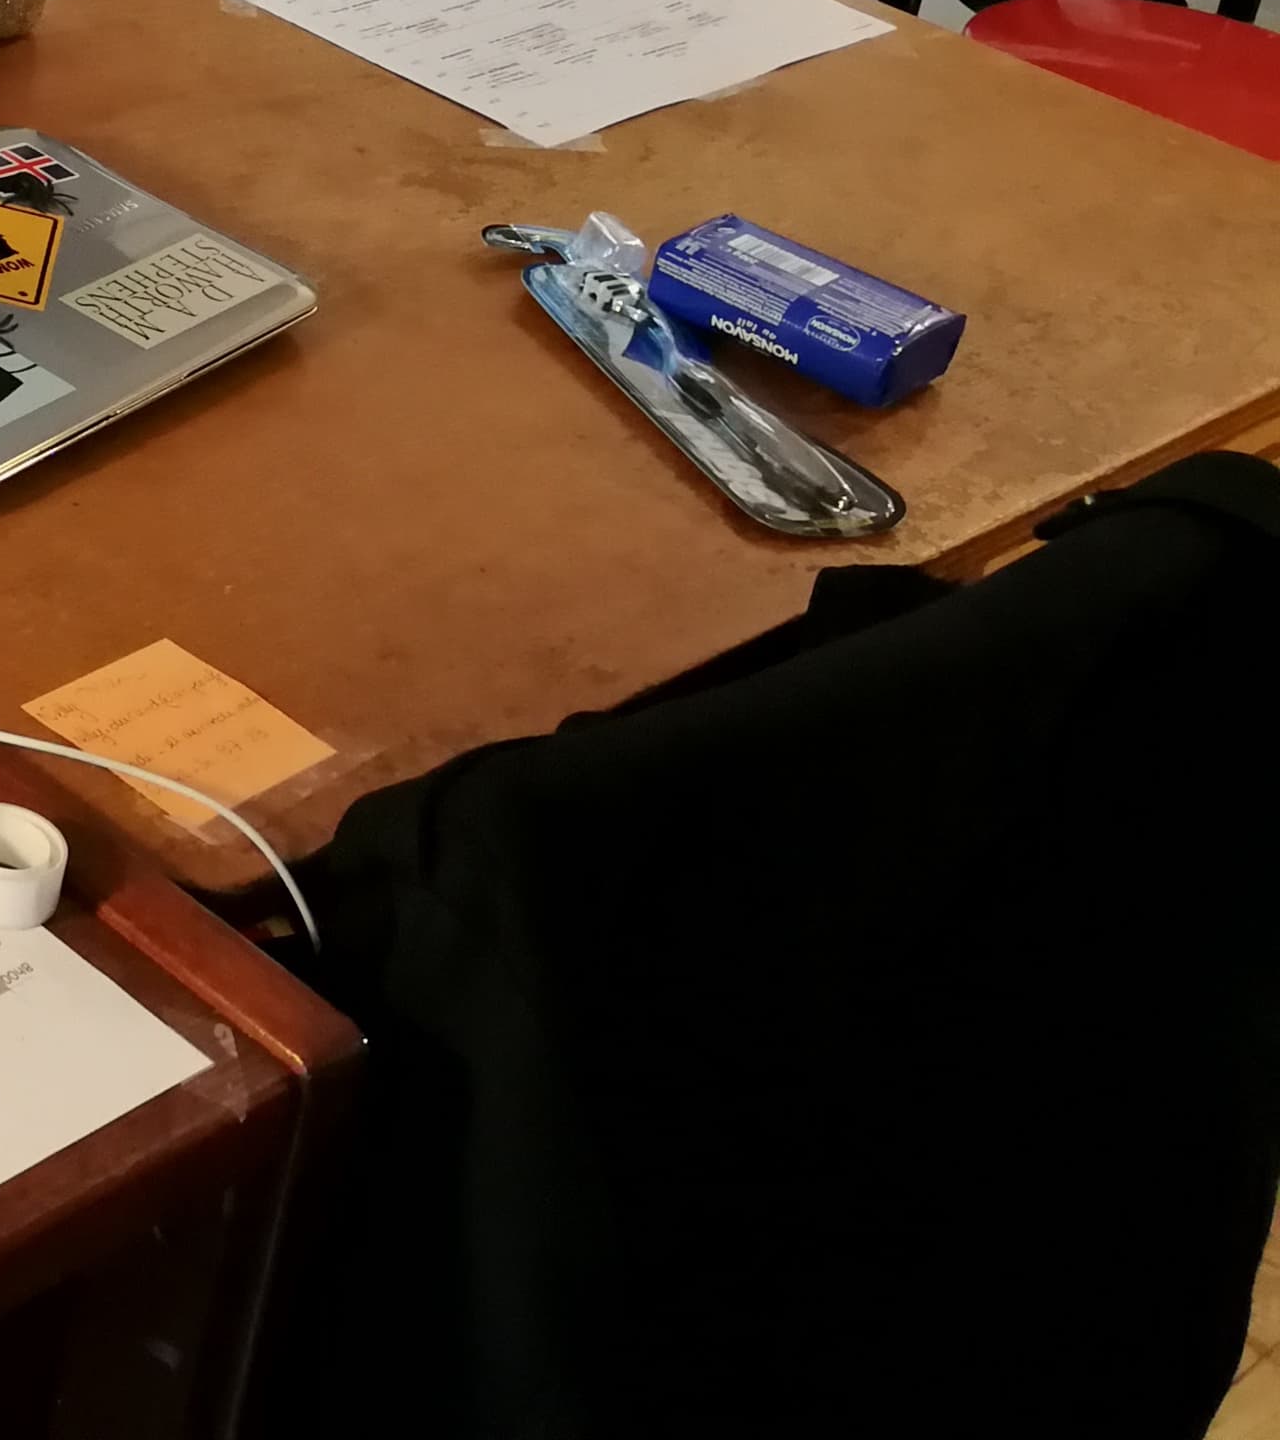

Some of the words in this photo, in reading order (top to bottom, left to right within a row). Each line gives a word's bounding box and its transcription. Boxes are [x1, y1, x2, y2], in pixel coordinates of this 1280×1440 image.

[74, 239, 222, 315] STEPHENS
[98, 253, 247, 329] HAWORTH
[710, 314, 799, 365] MONSAVON
[808, 318, 858, 346] MONSAVON
